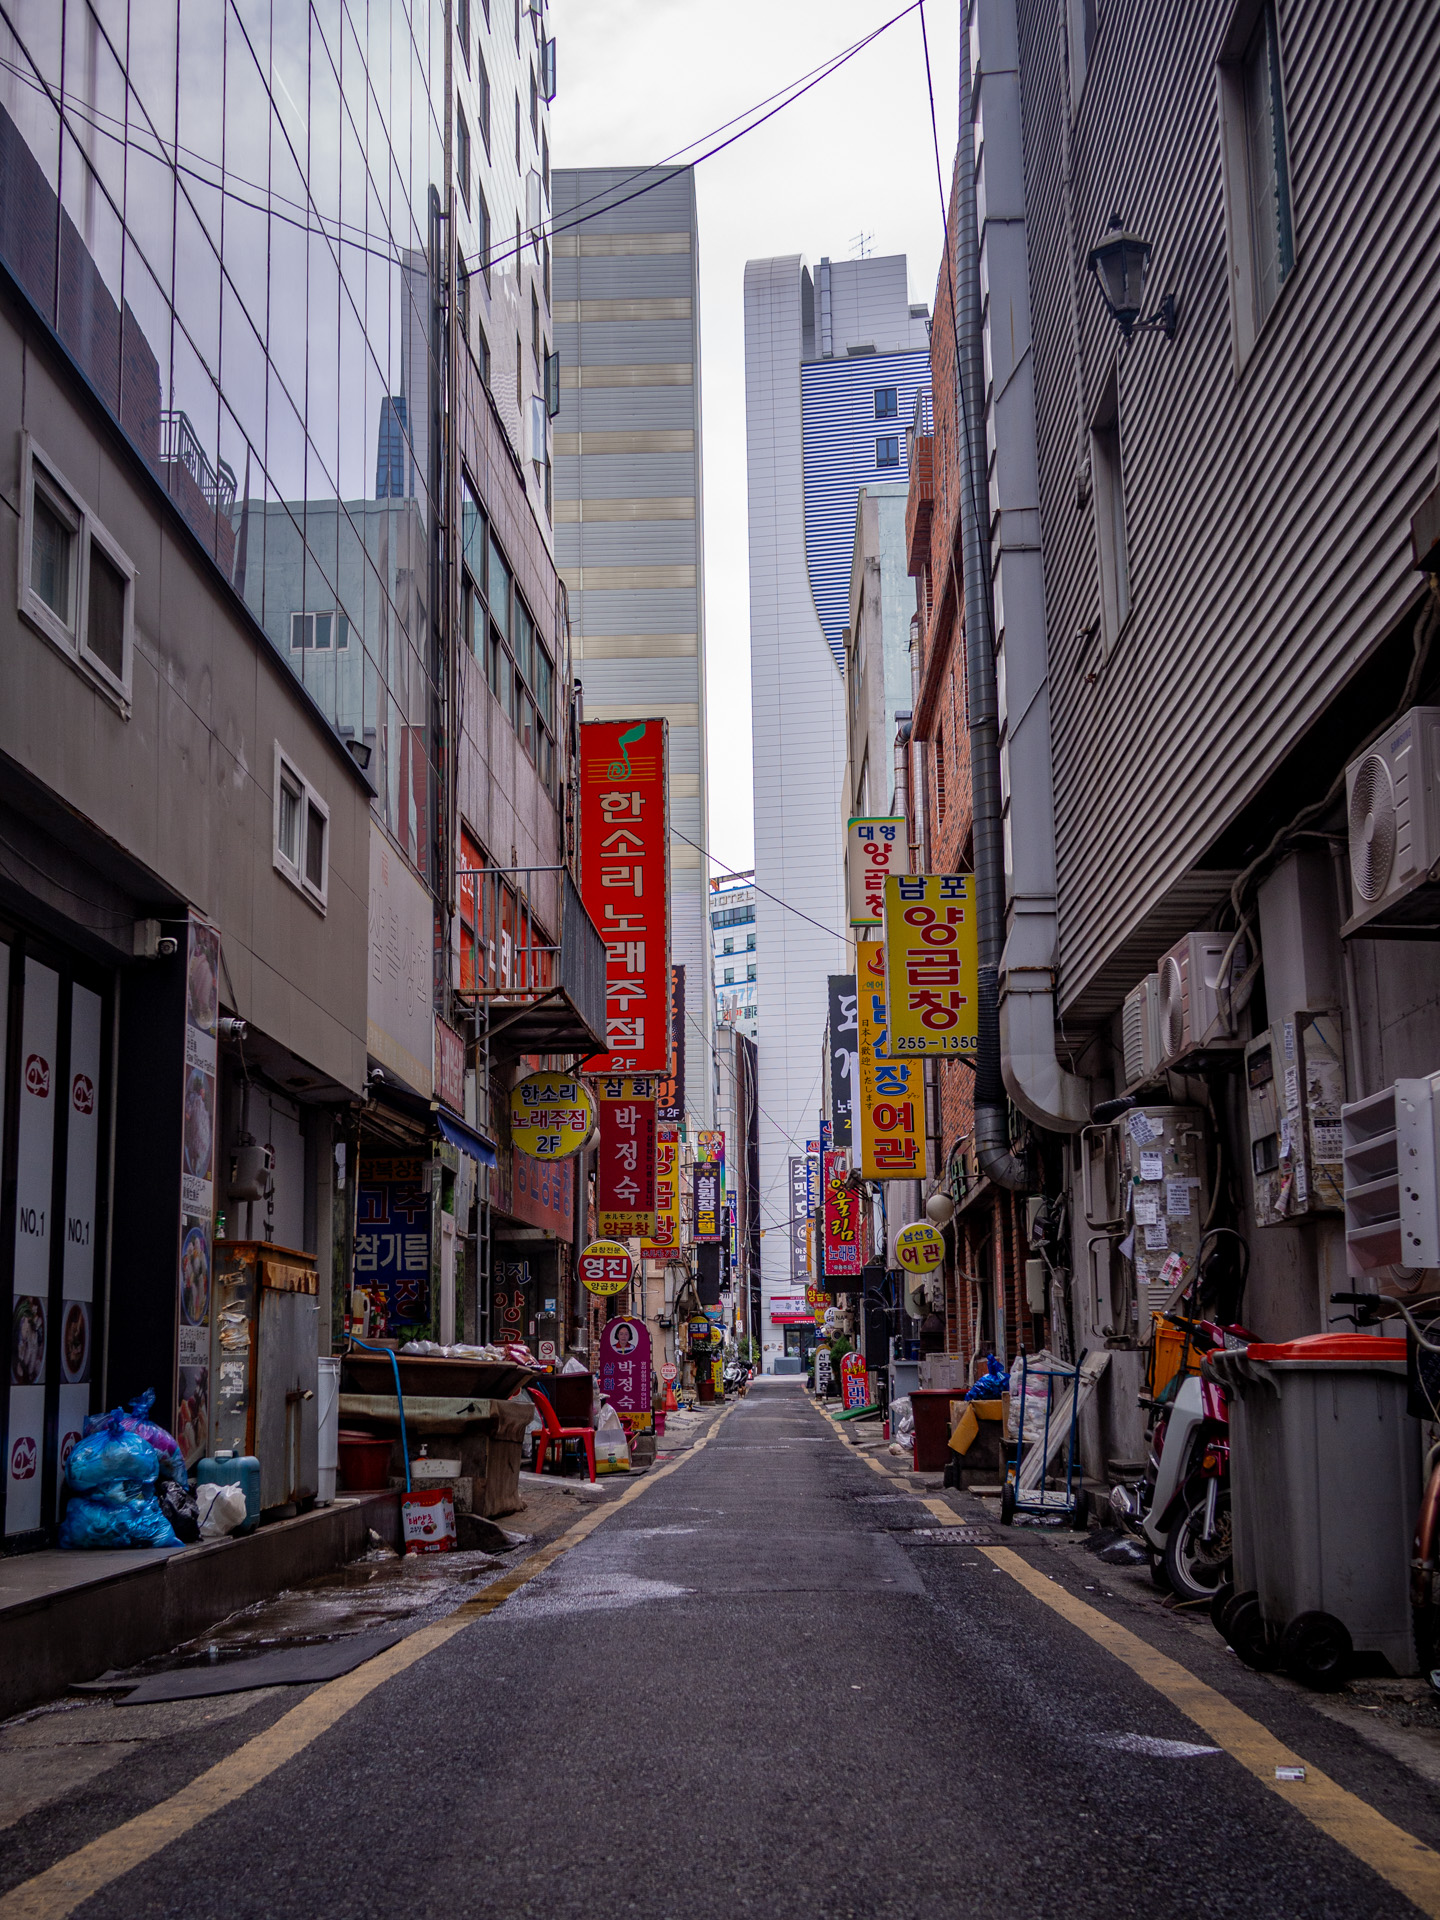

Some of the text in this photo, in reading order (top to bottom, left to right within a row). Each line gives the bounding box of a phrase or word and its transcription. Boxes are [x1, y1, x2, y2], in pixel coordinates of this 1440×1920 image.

[857, 824, 896, 842] 대영
[897, 876, 967, 901] 남포
[599, 791, 648, 1051] 한소리 노래주점
[902, 905, 967, 1031] 양곱창
[897, 1036, 978, 1050] 255-1350
[610, 1056, 638, 1070] 2F
[520, 1084, 578, 1106] 한소리
[603, 1079, 654, 1098] 삼화
[511, 1108, 587, 1132] 노래주점
[666, 1108, 680, 1118] 2F
[536, 1135, 562, 1154] 2F
[871, 1101, 920, 1170] 여관
[612, 1106, 643, 1207] 박정숙
[697, 1176, 717, 1211] 삼원장
[359, 1185, 428, 1225] 고추
[20, 1206, 45, 1238] NO.1
[68, 1216, 90, 1246] NO.1
[603, 1222, 650, 1237] 양곱창
[903, 1228, 934, 1243] 남선장
[355, 1233, 429, 1271] 참기름
[590, 1246, 621, 1254] 곱창전문
[829, 1244, 857, 1261] 노래방
[901, 1244, 941, 1265] 여관
[582, 1257, 628, 1279] 영진
[590, 1282, 619, 1292] 양곱창
[689, 1323, 708, 1332] 모텔
[603, 1363, 615, 1391] 삼화
[616, 1360, 637, 1411] 박정숙
[847, 1375, 867, 1409] 노래방
